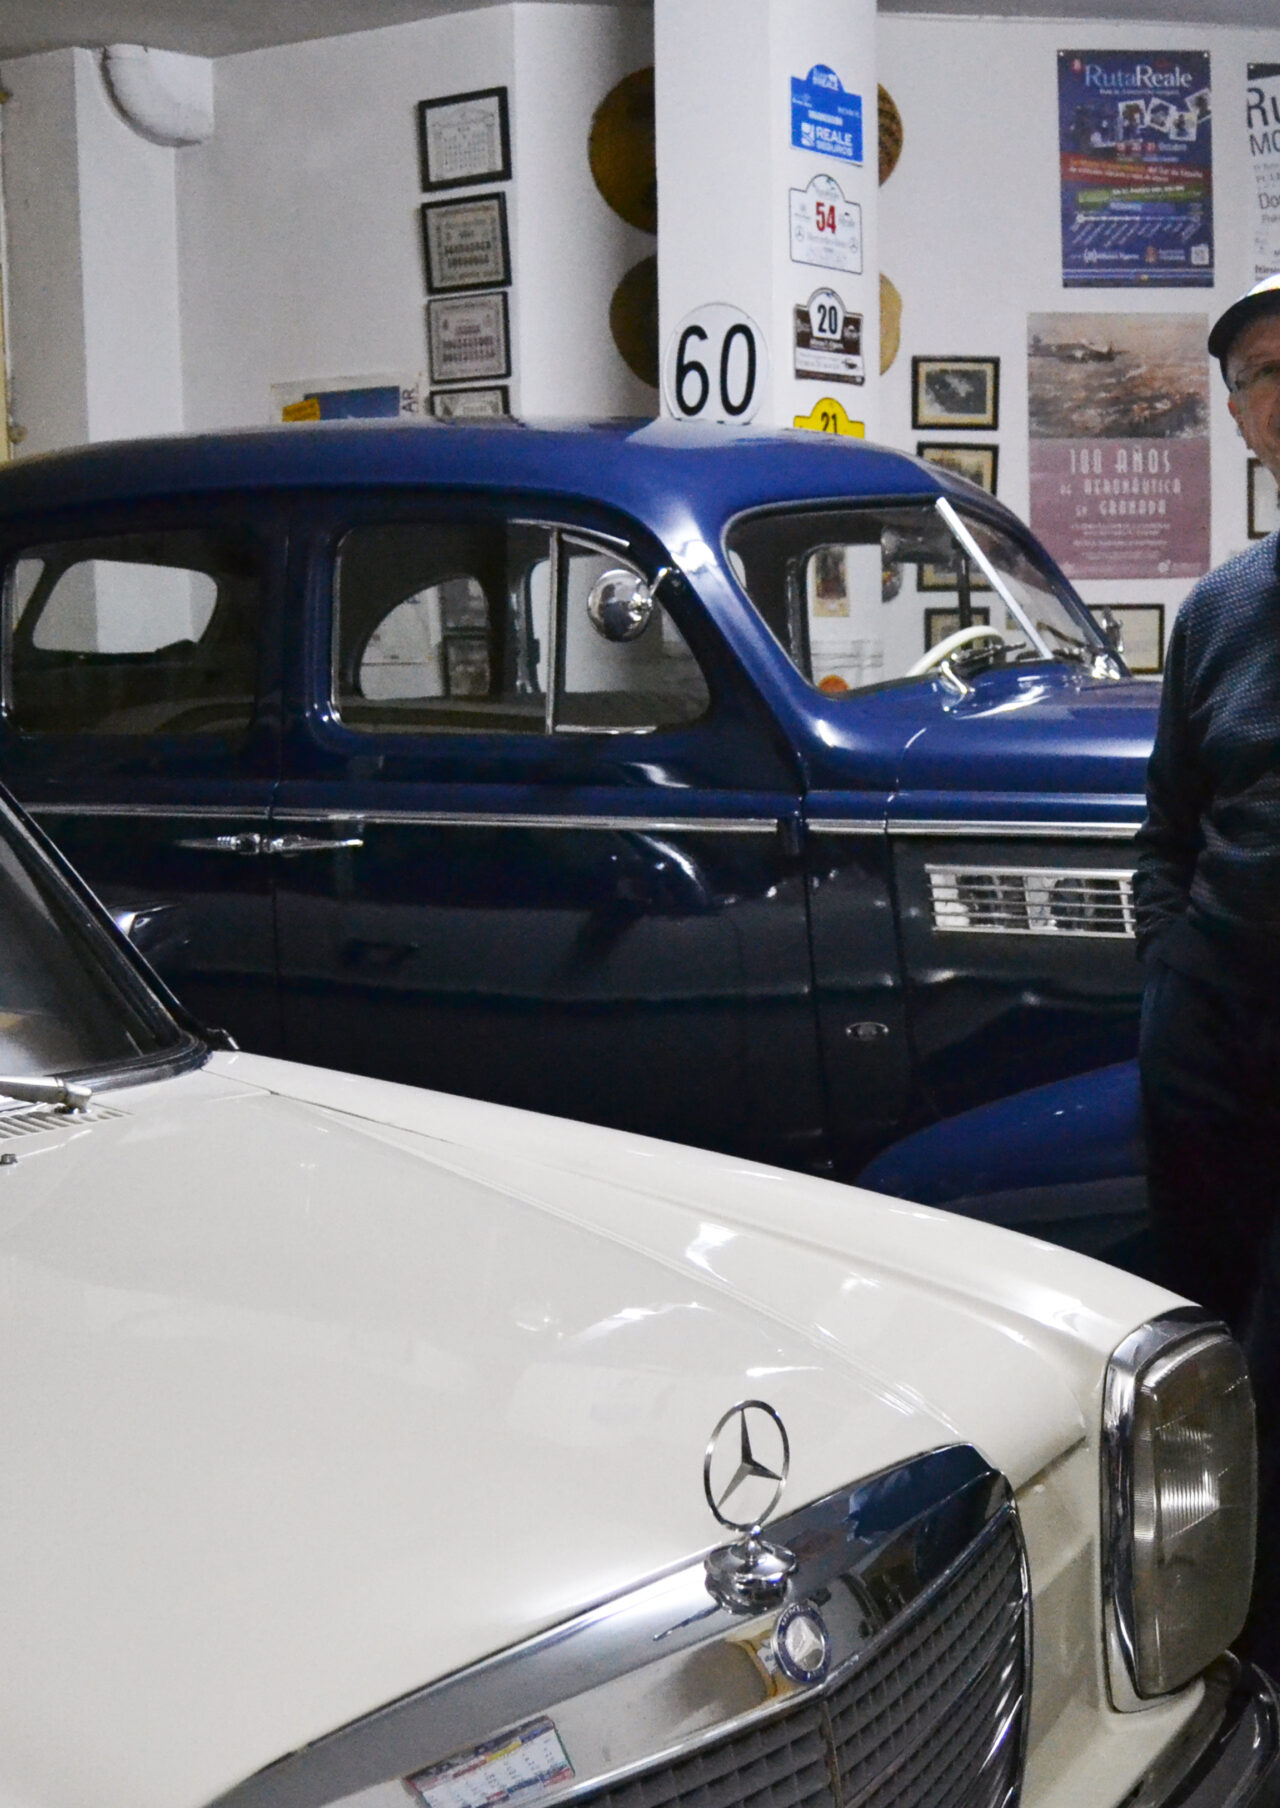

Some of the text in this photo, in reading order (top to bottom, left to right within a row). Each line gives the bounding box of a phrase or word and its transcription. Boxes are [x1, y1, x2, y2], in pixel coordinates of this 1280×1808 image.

[1085, 64, 1192, 87] RutaReale
[815, 126, 853, 146] REALE
[816, 201, 837, 234] 54
[817, 303, 838, 335] 20
[675, 323, 757, 417] 60
[821, 410, 838, 435] 21
[1115, 445, 1171, 474] AÑOS
